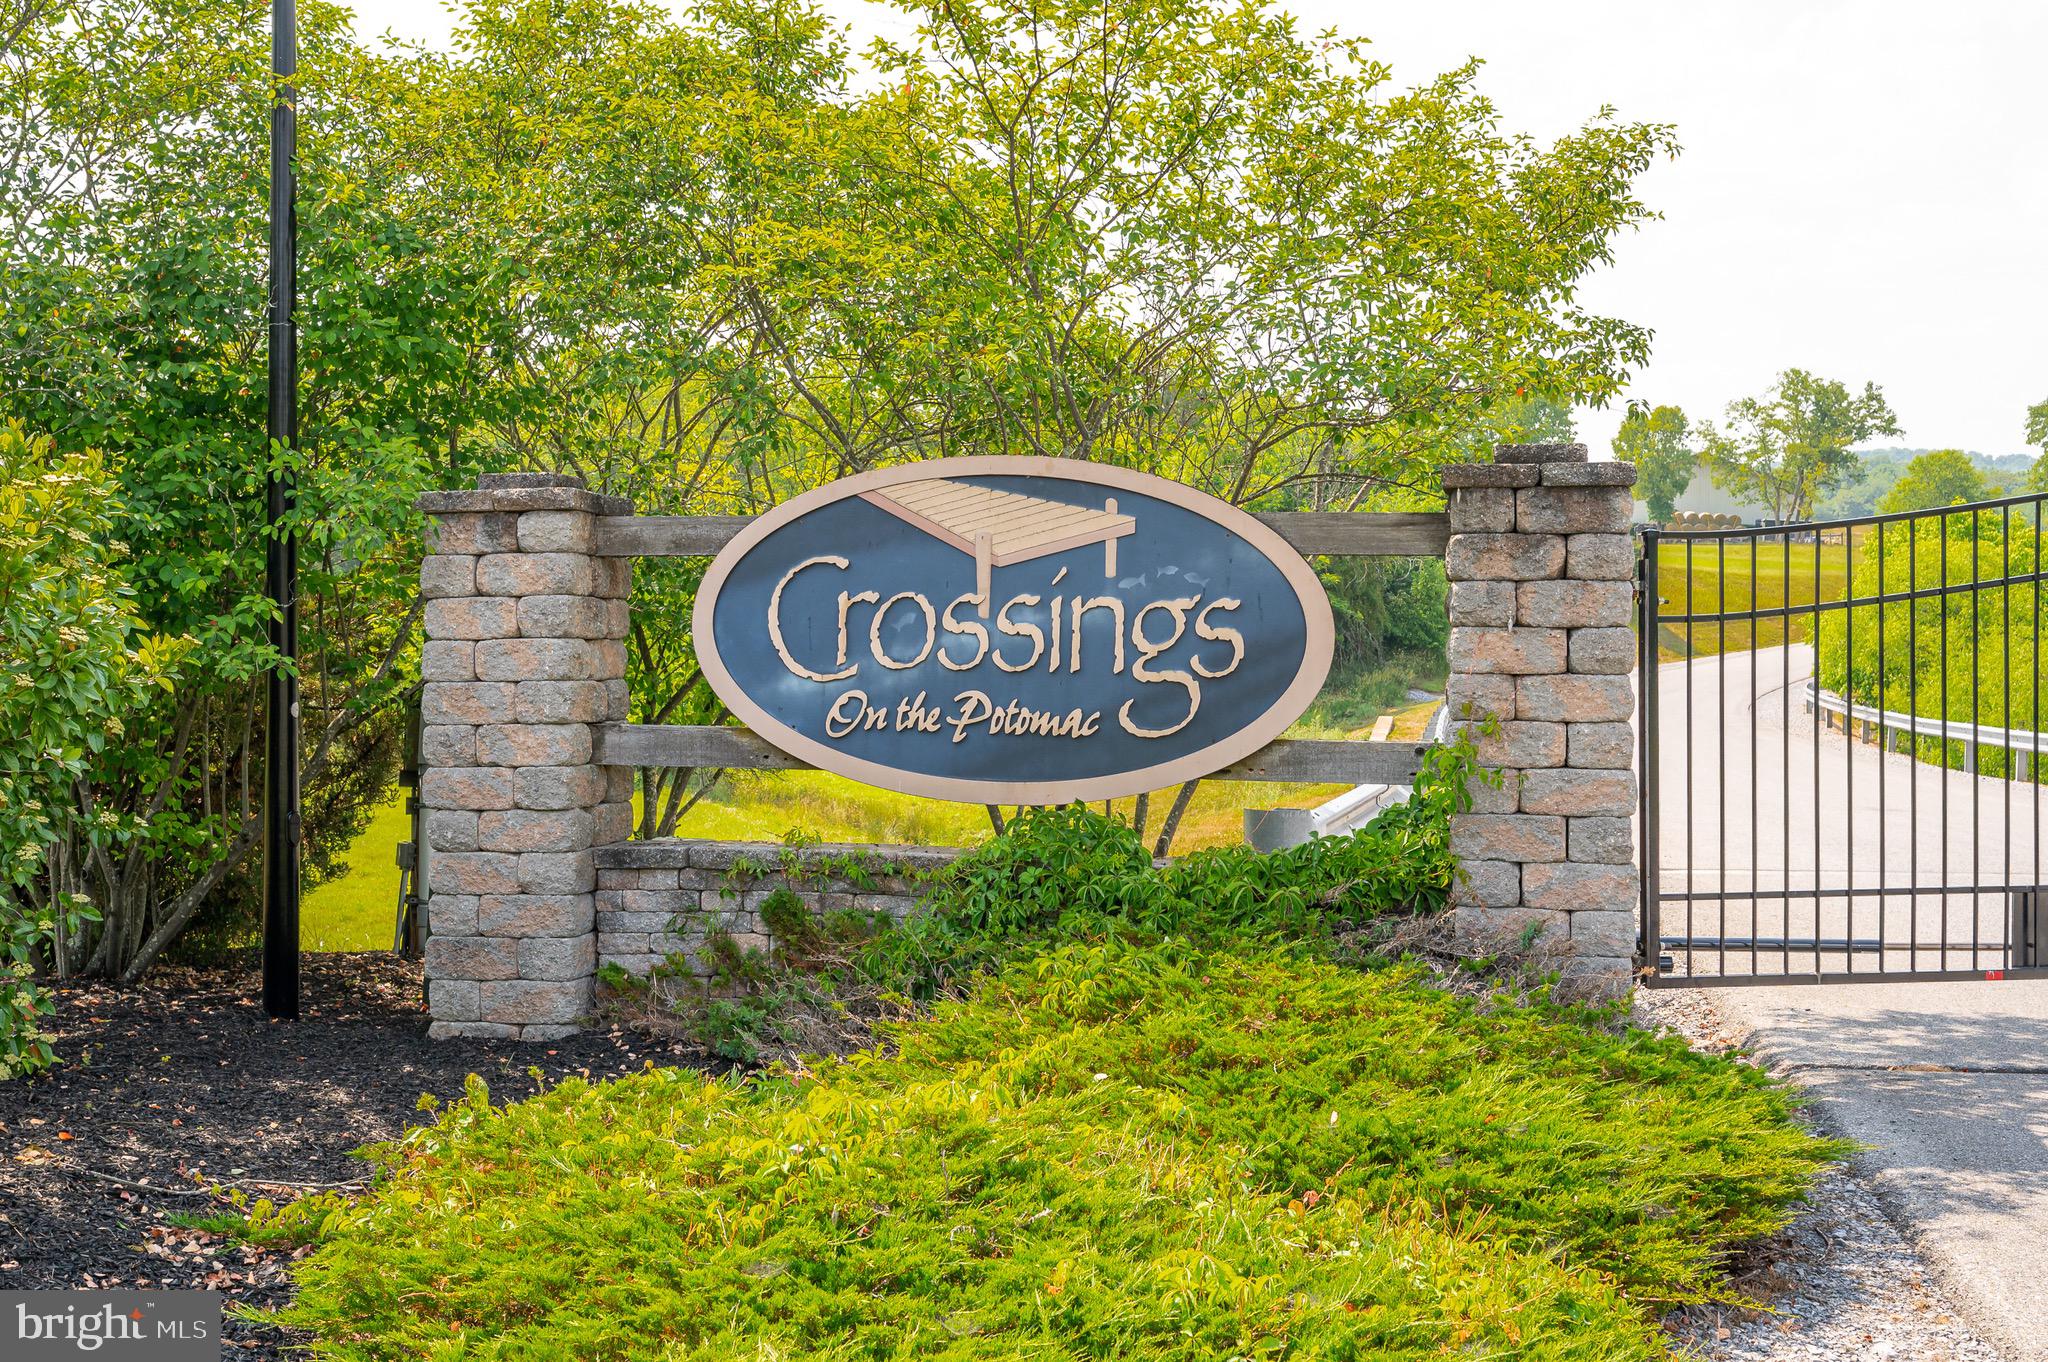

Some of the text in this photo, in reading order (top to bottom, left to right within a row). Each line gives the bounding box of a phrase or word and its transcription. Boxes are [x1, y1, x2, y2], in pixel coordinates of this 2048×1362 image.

[767, 556, 1246, 738] Crossings
[825, 689, 1102, 743] On the Potomac
